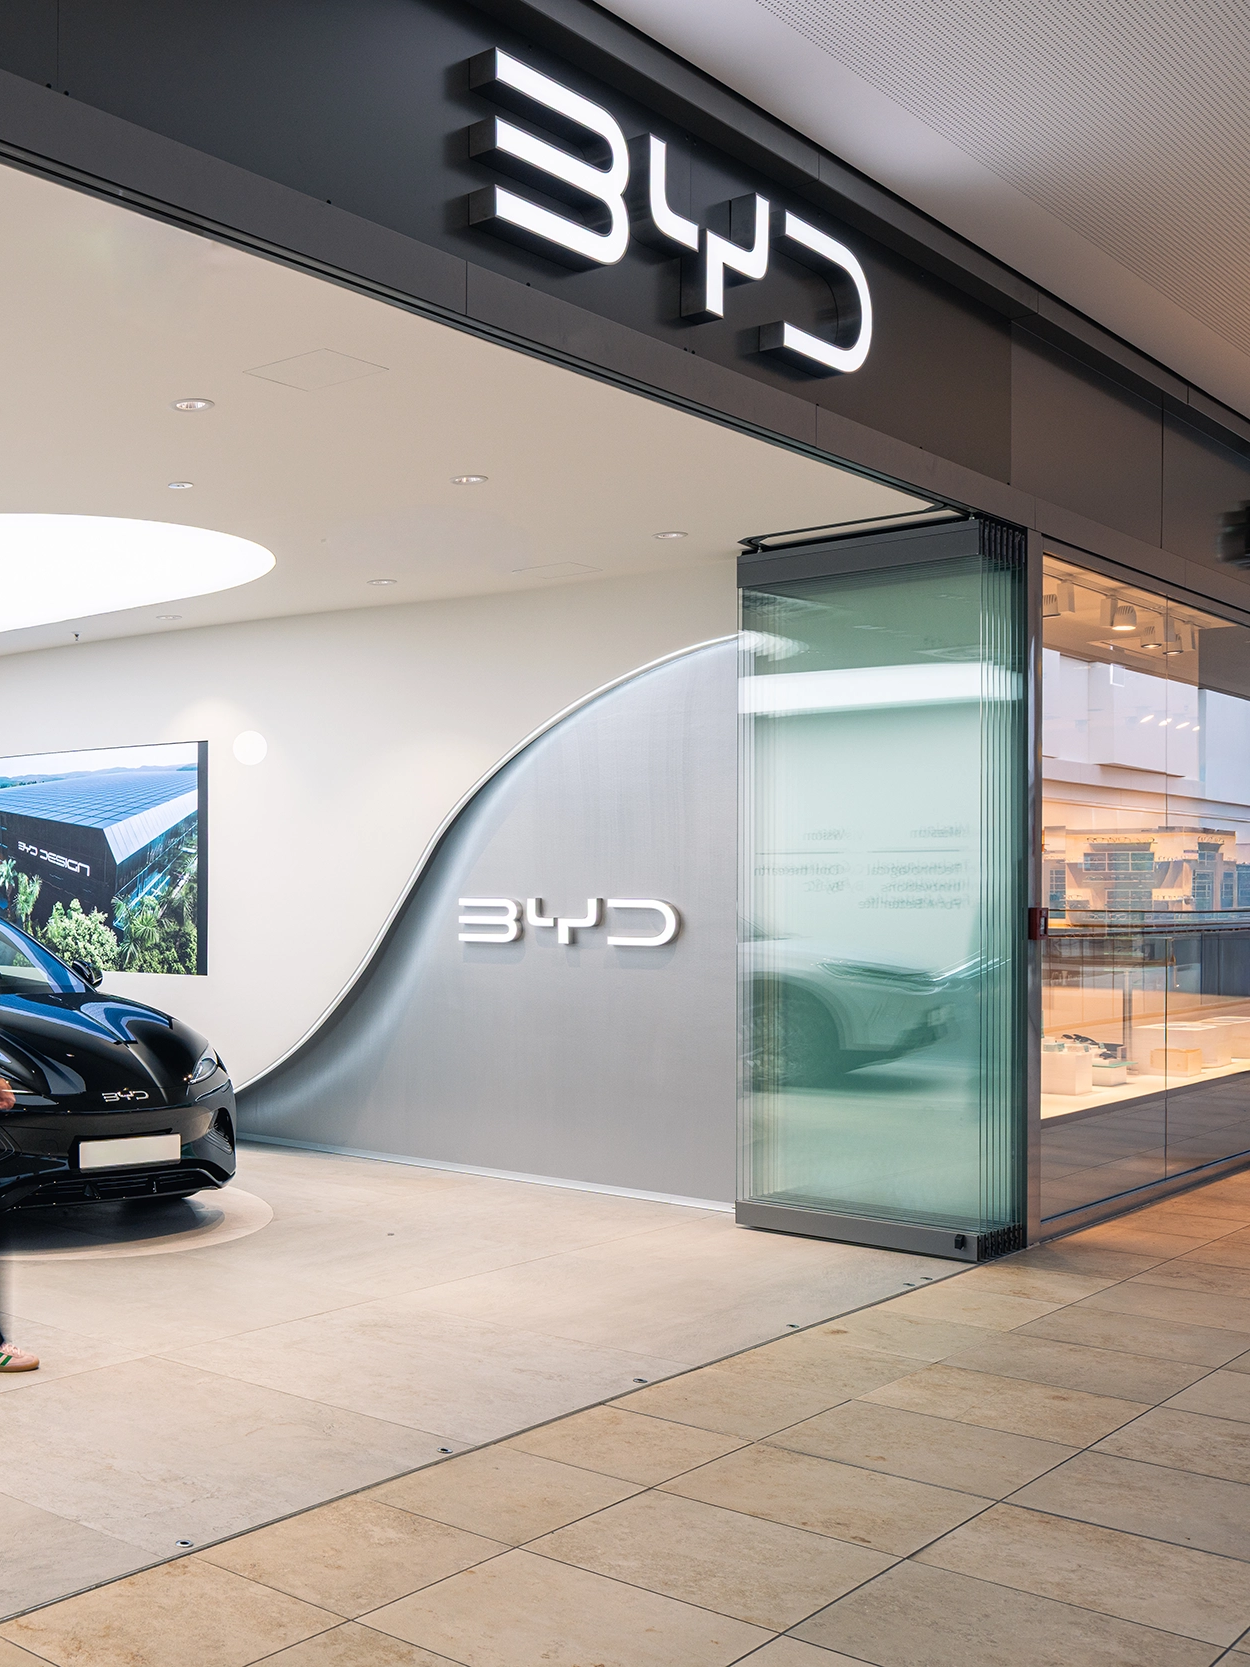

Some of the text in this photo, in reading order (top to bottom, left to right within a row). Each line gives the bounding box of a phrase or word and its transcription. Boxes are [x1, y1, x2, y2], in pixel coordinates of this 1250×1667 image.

[492, 46, 873, 374] BYD
[17, 840, 91, 877] BYD DESIGN
[458, 898, 681, 947] BYD
[101, 1090, 150, 1102] BYD
